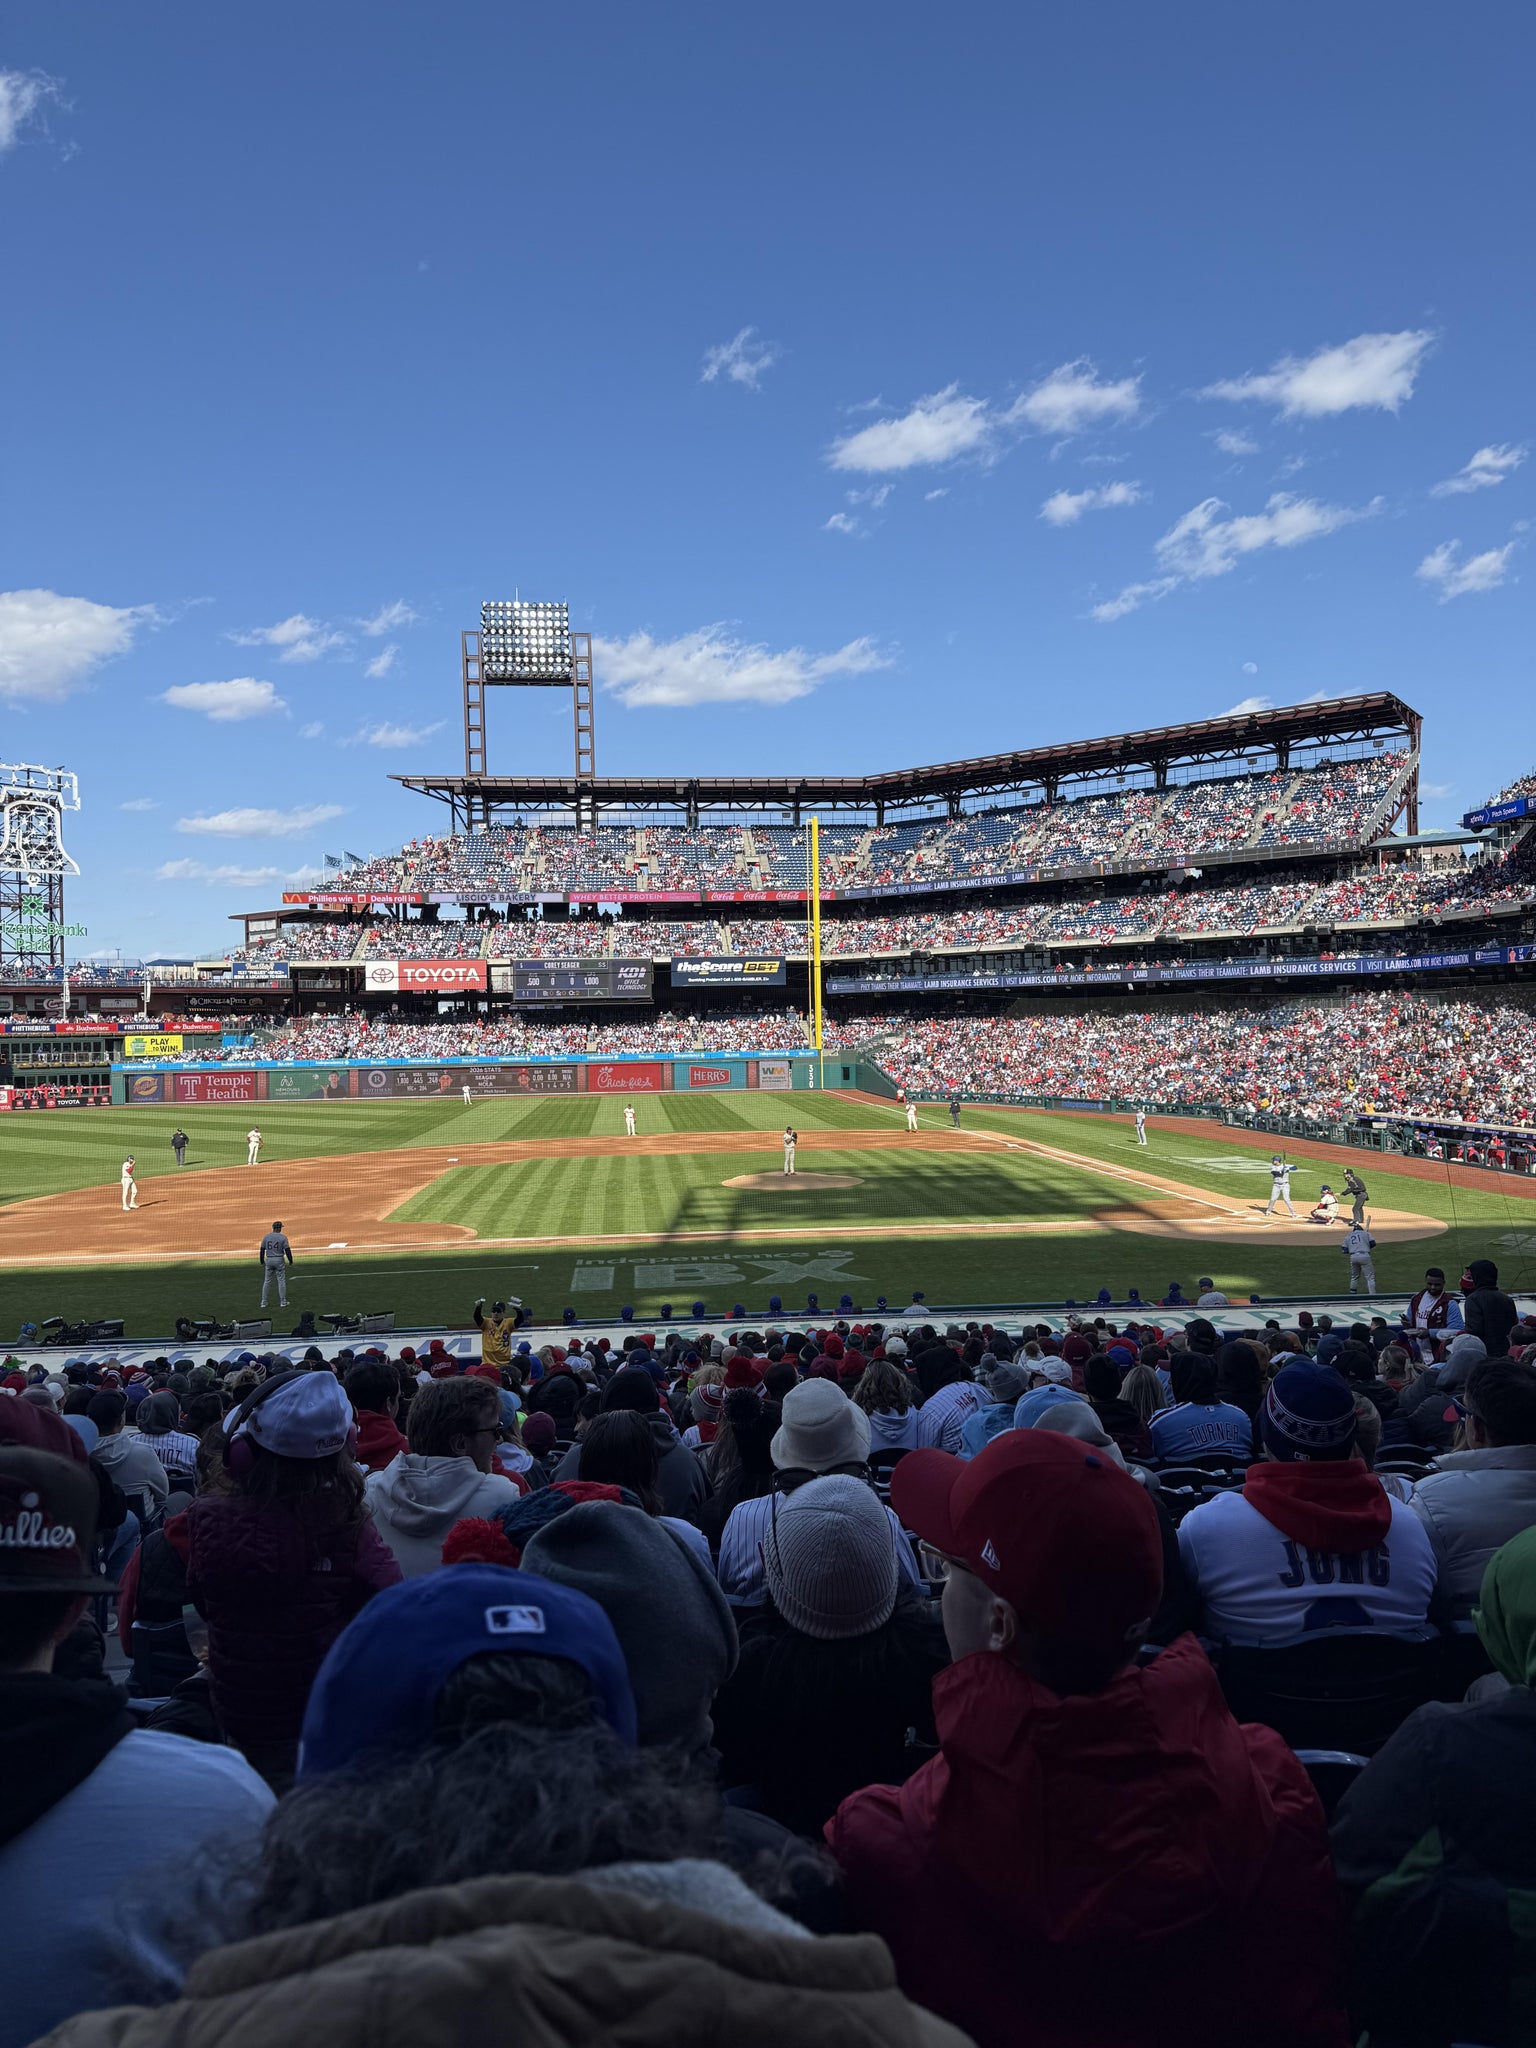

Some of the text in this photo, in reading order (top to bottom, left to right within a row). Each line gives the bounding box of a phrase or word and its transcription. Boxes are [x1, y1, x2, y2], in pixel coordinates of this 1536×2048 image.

[1503, 807, 1517, 816] Speed
[934, 882, 949, 890] LAMB
[951, 878, 981, 888] INSURANCE
[982, 875, 1007, 886] SERVICES
[1011, 873, 1025, 881] LAMB
[308, 895, 337, 903] Phillies
[371, 895, 416, 903] Deals roll in
[456, 893, 537, 902] LISCIO'S BAKERY
[600, 893, 627, 901] BETTER
[629, 893, 663, 901] PROTEIN
[47, 922, 86, 936] Bank
[16, 938, 49, 952] Park
[544, 961, 560, 969] COREY
[561, 961, 580, 969] SEAGER
[746, 963, 777, 971] BET
[1367, 961, 1382, 970] VISIT
[1385, 959, 1421, 970] LAMBIS.COM
[403, 968, 480, 983] TOYOTA
[1133, 970, 1148, 979] LAMB
[1160, 962, 1356, 979] PHLY THANKS THEIR TEAMMATE: LAMB INSURANCE SERVICES
[527, 978, 540, 986] .500
[924, 980, 939, 989] LAMB
[941, 979, 972, 988] INSURANCE
[973, 978, 998, 987] SERVICES
[1006, 972, 1121, 985] VISIT LAMBIS.COM FOR MORE INFORMATION
[693, 1070, 725, 1082] HERR'S
[762, 1067, 785, 1075] WM
[205, 1075, 251, 1087] Temple
[597, 1067, 653, 1089] Chick-fil-A
[206, 1088, 249, 1099] Health
[1350, 1234, 1361, 1245] 21
[267, 1240, 279, 1251] 64
[575, 1252, 810, 1265] Independence
[569, 1257, 876, 1292] IBX
[1248, 1305, 1402, 1330] Park
[1187, 1421, 1239, 1447] TURNER
[0, 1511, 76, 1549] illies
[1278, 1540, 1391, 1587] JUNG
